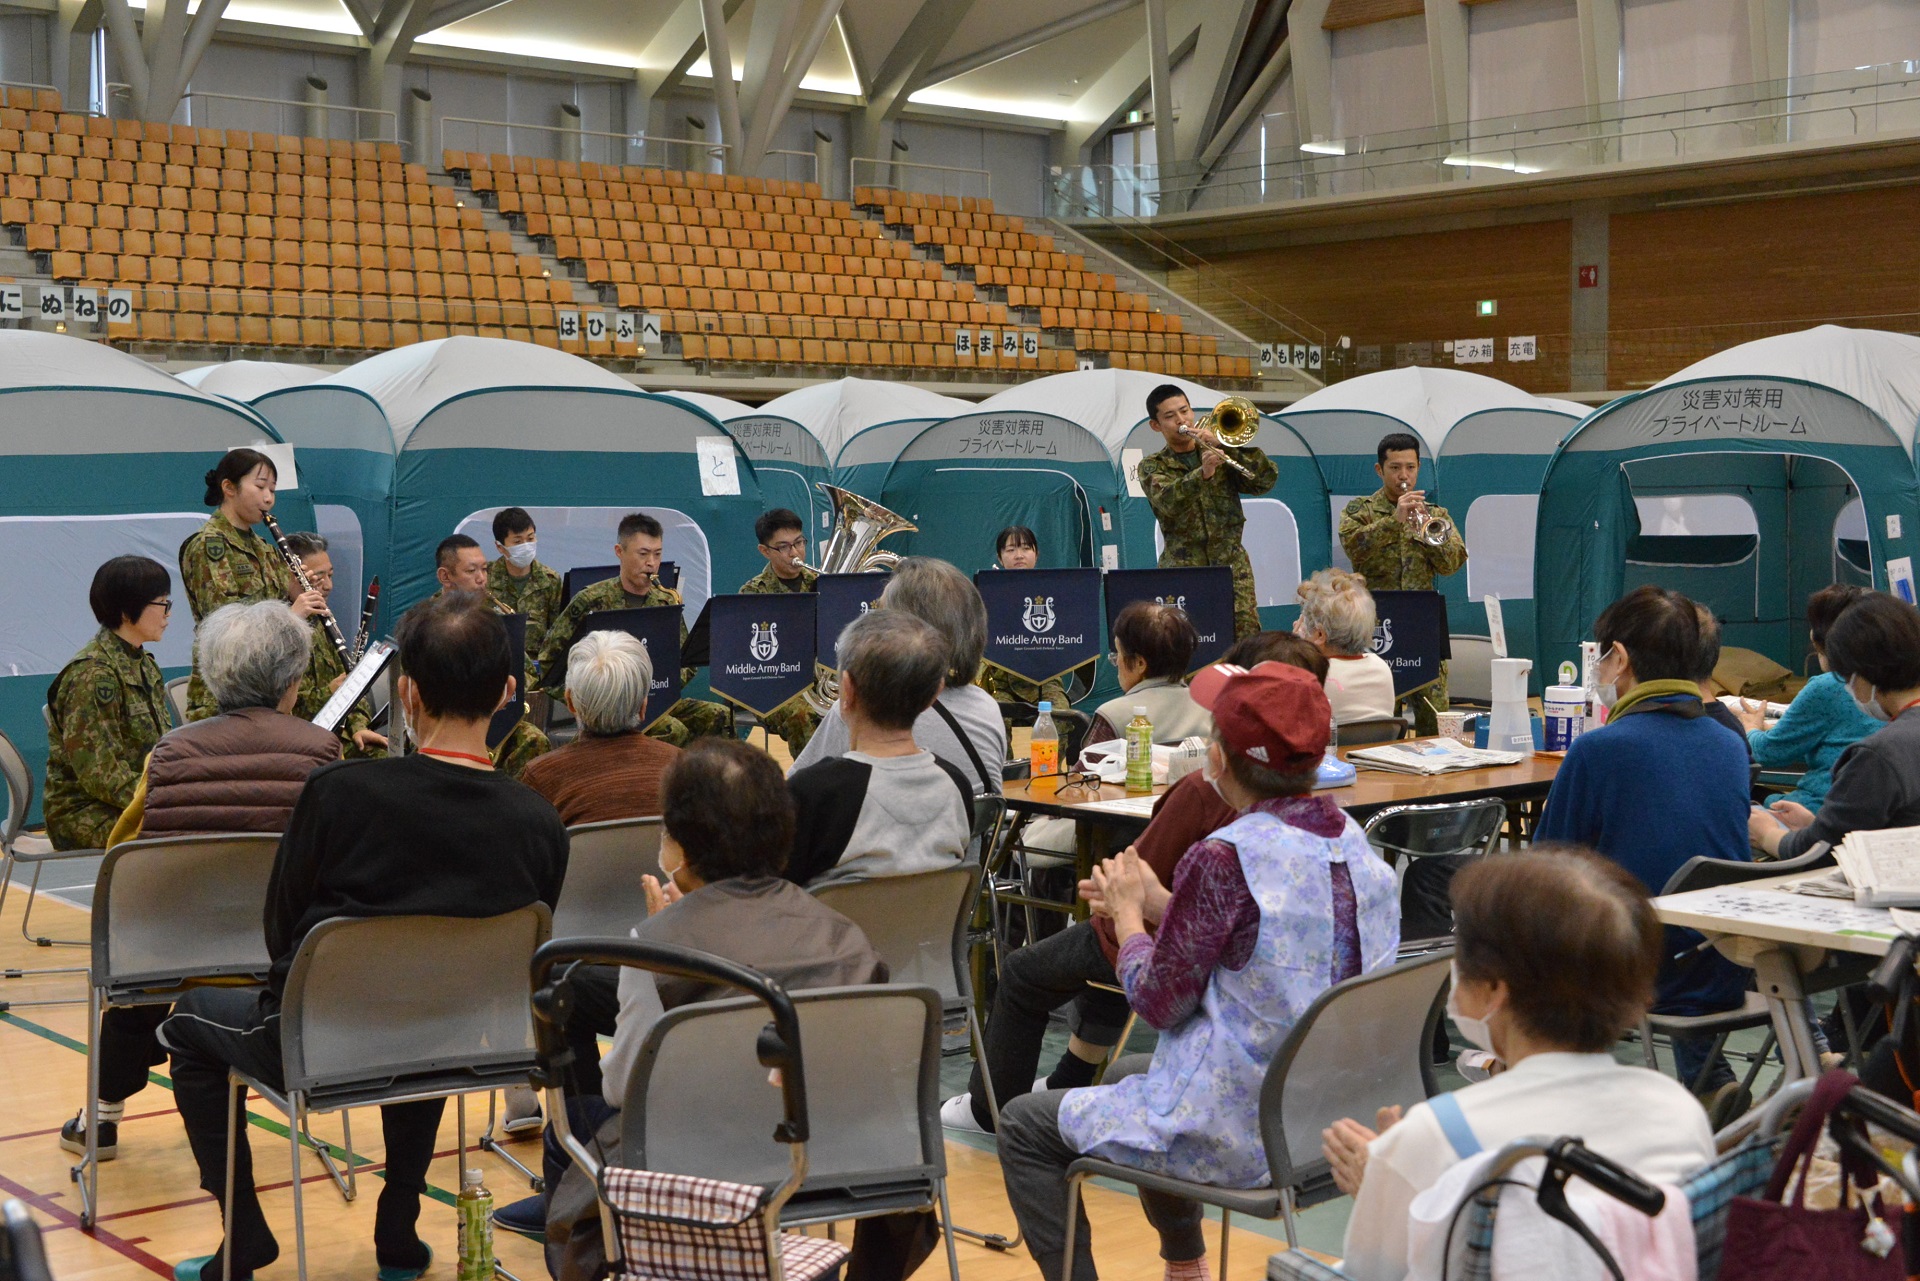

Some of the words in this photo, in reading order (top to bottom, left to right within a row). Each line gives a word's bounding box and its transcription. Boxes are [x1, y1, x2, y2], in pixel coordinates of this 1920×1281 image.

[1455, 343, 1493, 358] ごみ箱
[1510, 342, 1534, 357] 充電
[1681, 388, 1783, 411] 災害対策用
[733, 422, 782, 438] 災害対策用
[978, 419, 1044, 436] 災害対策用
[1653, 414, 1807, 437] プライベートルーム
[740, 440, 792, 456] ベートルーム
[959, 437, 1057, 455] プライベートルーム
[712, 455, 726, 476] と
[995, 634, 1030, 645] Middle
[1031, 635, 1057, 647] Army
[1058, 633, 1083, 644] Band
[1197, 632, 1216, 643] and
[726, 663, 756, 675] Middle
[758, 663, 779, 675] Army
[780, 661, 801, 673] Band
[1396, 656, 1422, 667] Band
[651, 677, 669, 689] Band
